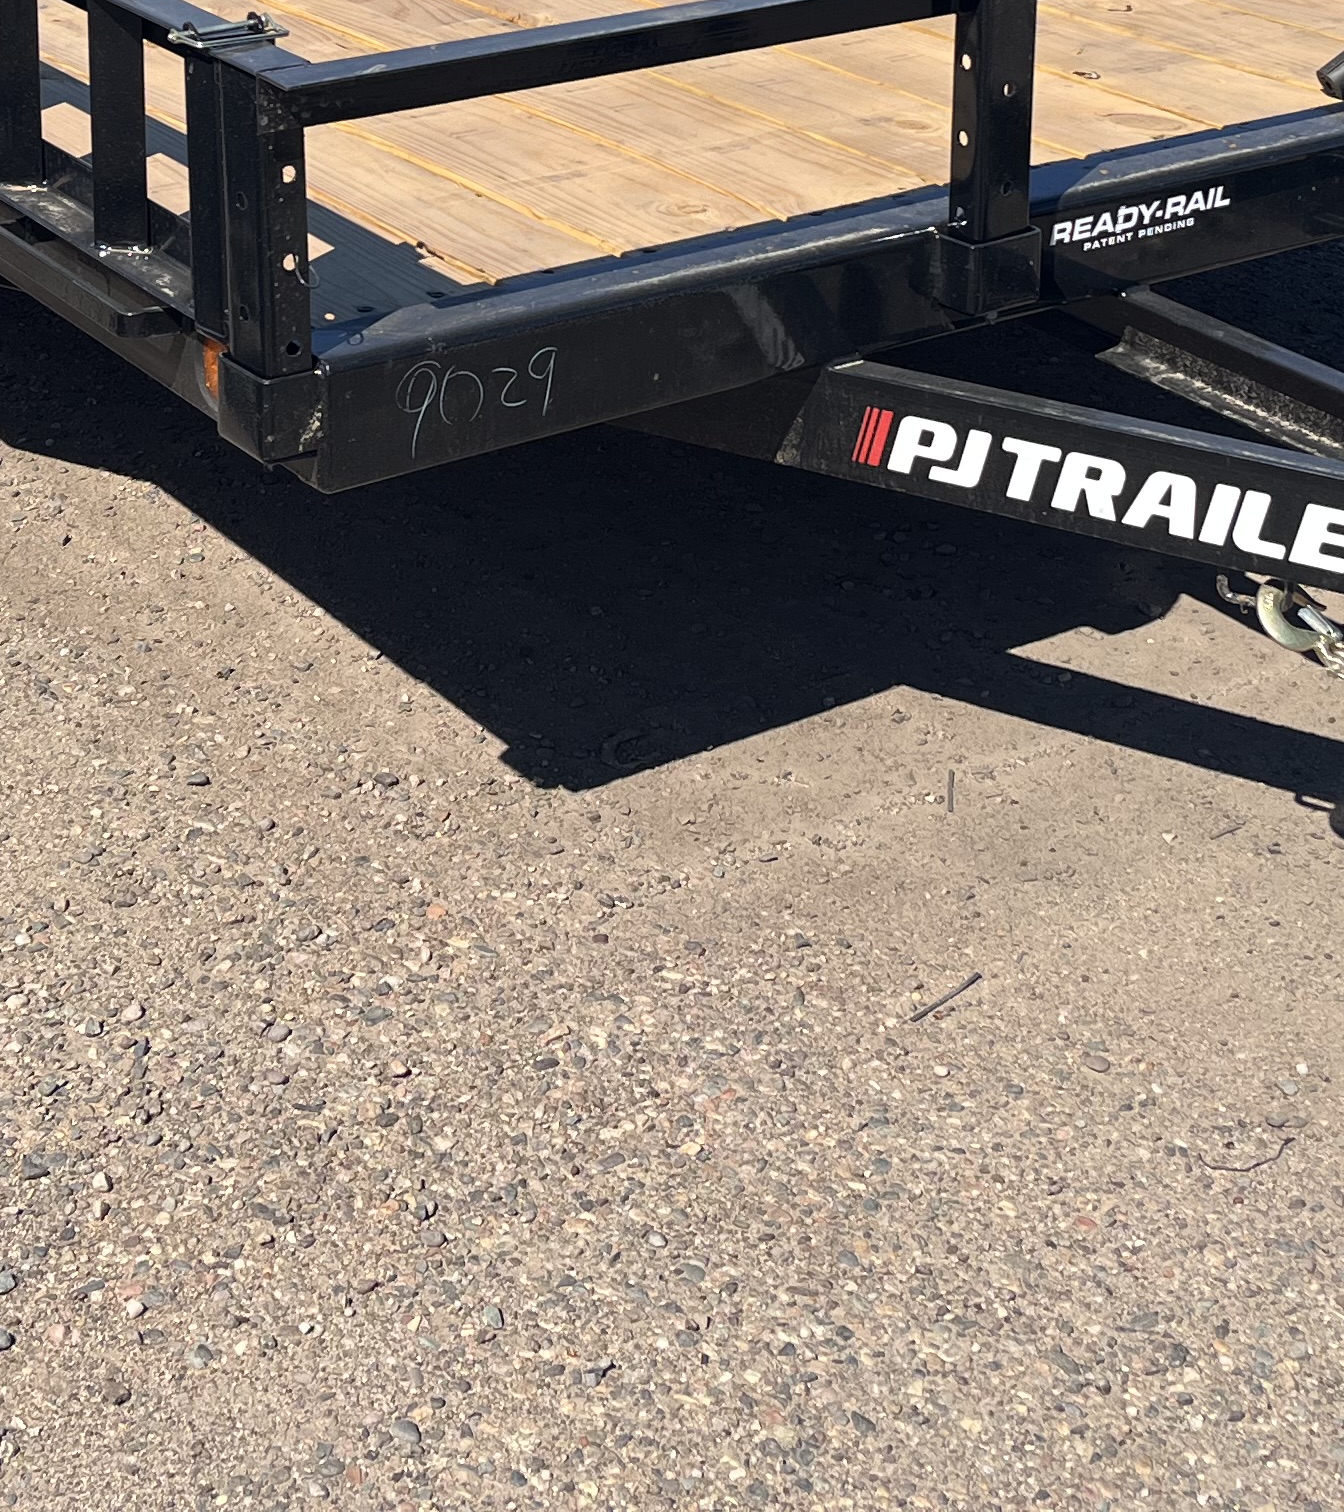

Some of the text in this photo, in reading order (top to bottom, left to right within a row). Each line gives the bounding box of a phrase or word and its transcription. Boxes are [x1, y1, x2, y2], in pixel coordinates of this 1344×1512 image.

[1049, 185, 1231, 247] READY-RAIL
[1083, 217, 1195, 252] PATENT PENDING
[395, 347, 558, 459] 9029
[886, 414, 993, 489] PJ
